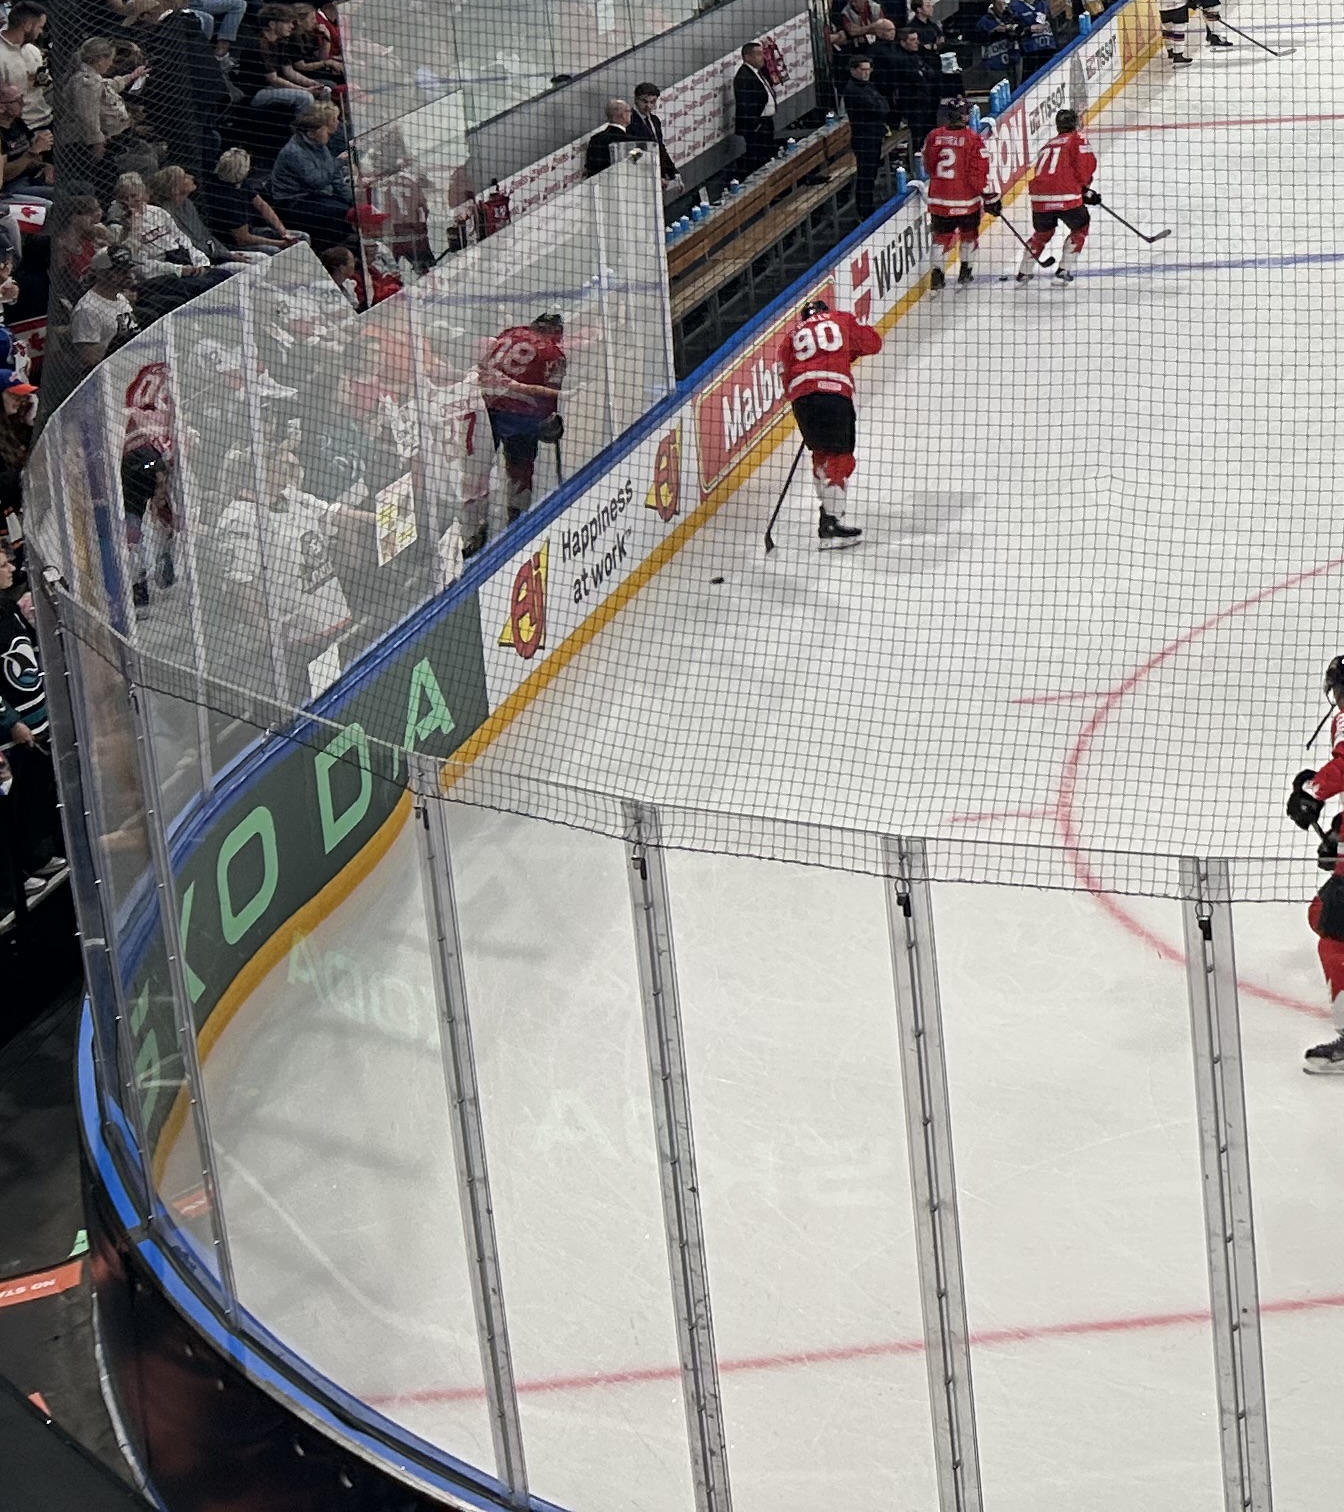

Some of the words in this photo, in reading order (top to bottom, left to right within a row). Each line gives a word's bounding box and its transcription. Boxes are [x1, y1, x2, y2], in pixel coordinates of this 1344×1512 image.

[936, 147, 957, 180] 2
[791, 319, 844, 362] 90
[561, 478, 634, 564] Happiness
[573, 569, 591, 605] at
